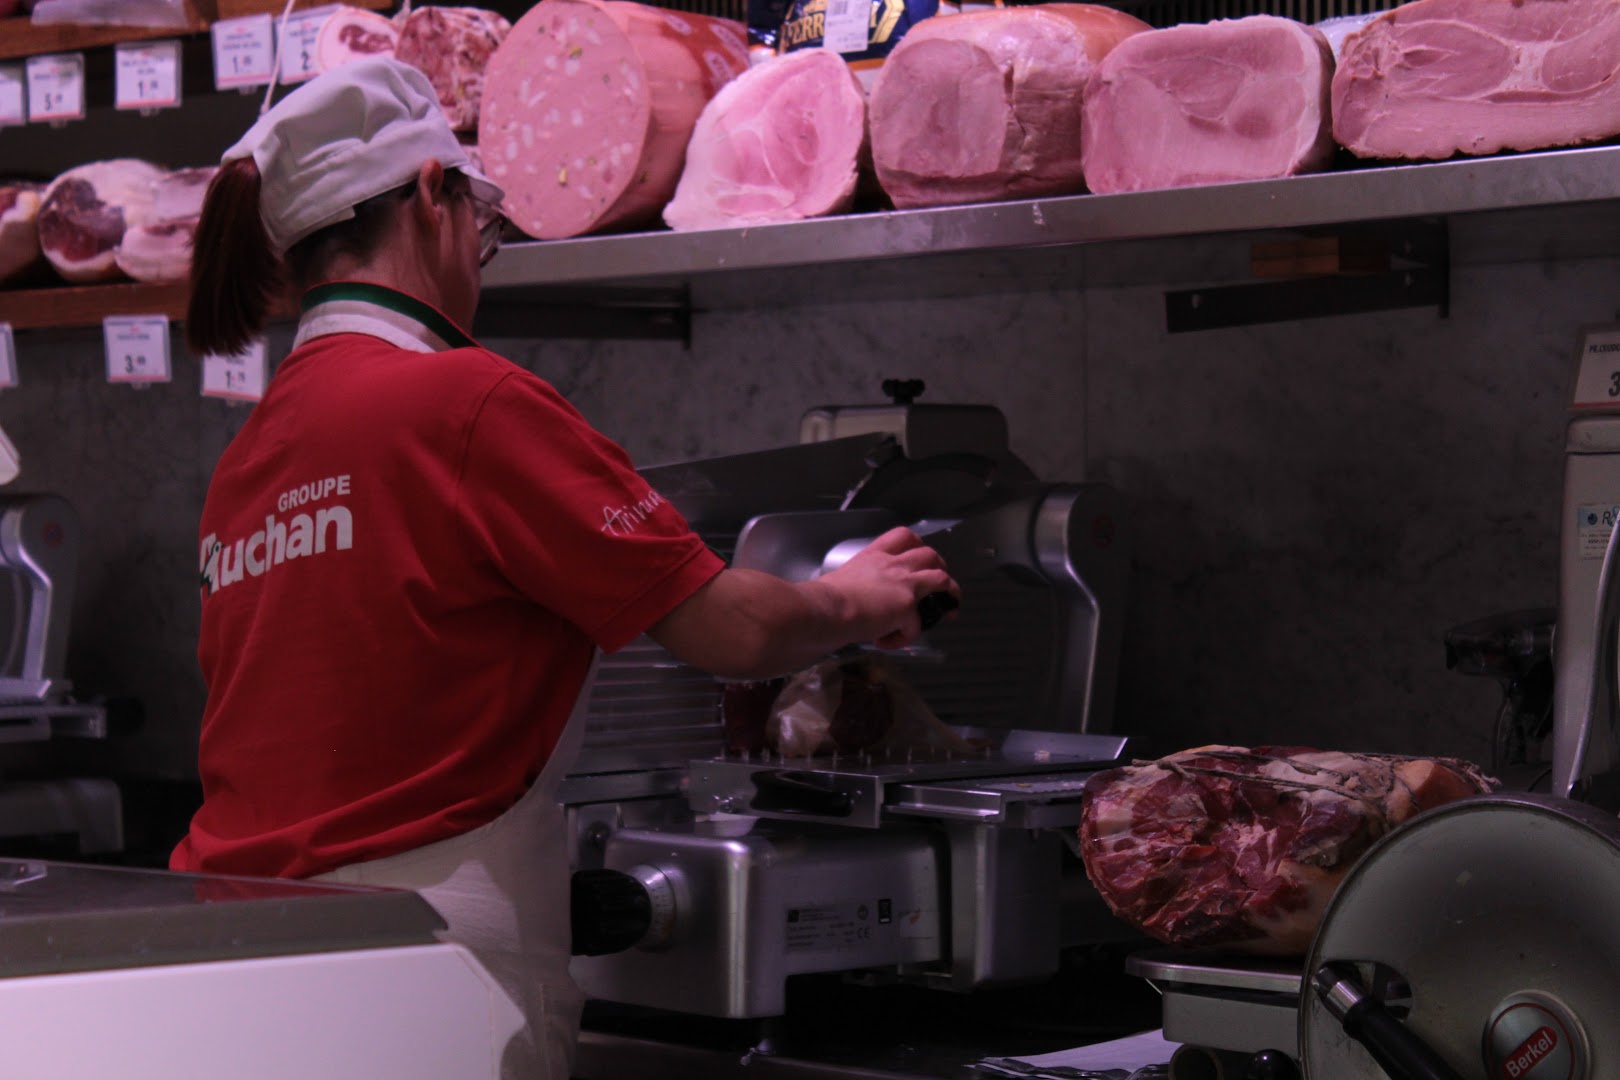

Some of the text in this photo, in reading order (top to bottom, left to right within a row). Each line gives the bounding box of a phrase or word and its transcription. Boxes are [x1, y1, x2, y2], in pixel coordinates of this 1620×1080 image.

[1608, 371, 1620, 397] 3
[278, 474, 351, 513] GROUPE
[200, 505, 353, 594] Auchan
[1505, 1029, 1553, 1079] Berkel
